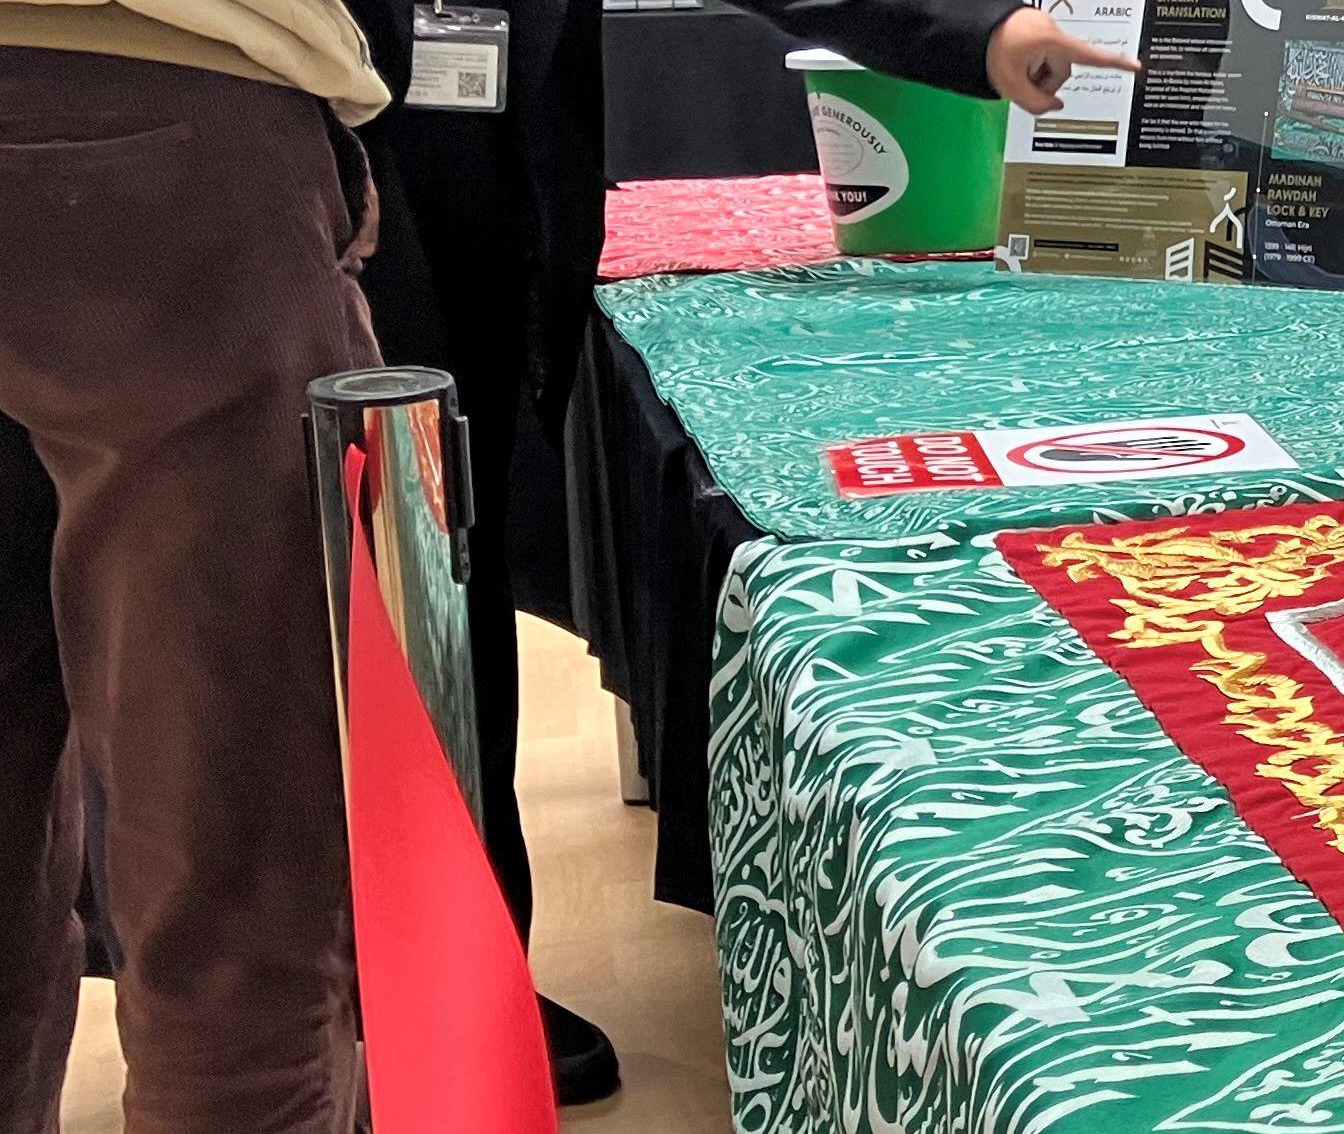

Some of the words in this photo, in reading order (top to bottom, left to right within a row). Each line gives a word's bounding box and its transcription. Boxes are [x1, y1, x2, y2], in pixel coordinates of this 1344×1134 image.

[1095, 7, 1132, 17] ARABIC
[1156, 6, 1227, 19] TRANSLATION
[821, 106, 887, 155] GENEROUSLY
[1268, 173, 1322, 187] MADINAH
[841, 191, 867, 203] YOU!
[1267, 189, 1317, 202] RAWDAH
[1266, 205, 1295, 216] LOCK
[1298, 206, 1306, 216] &
[1309, 207, 1330, 218] KEY
[849, 439, 914, 486] TOUCH
[926, 454, 986, 483] NOT
